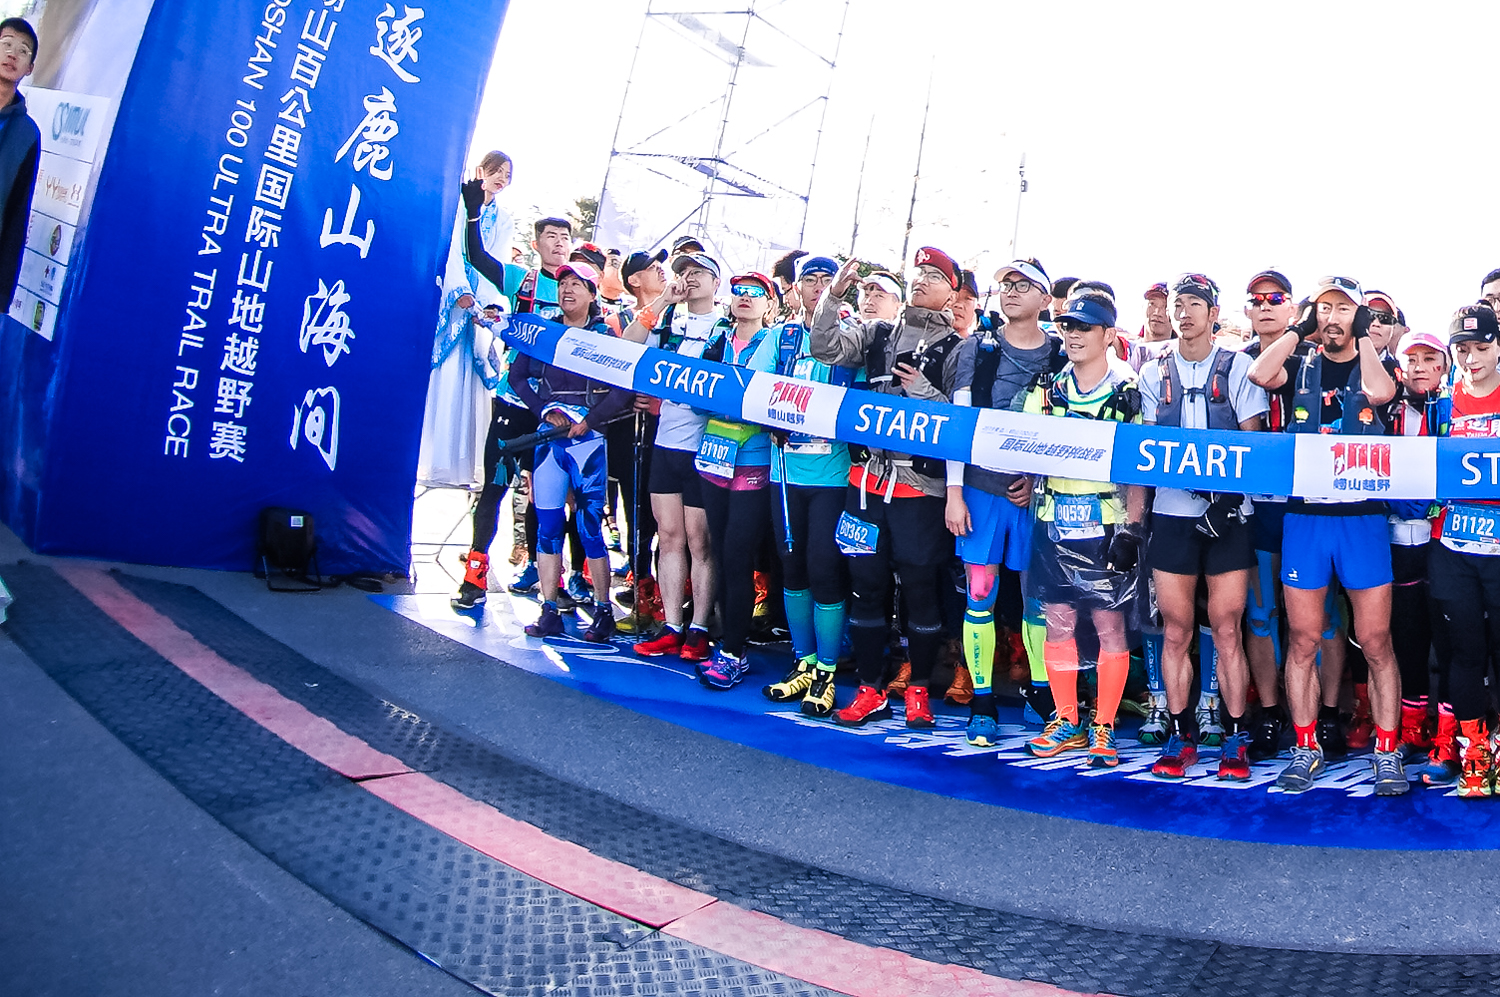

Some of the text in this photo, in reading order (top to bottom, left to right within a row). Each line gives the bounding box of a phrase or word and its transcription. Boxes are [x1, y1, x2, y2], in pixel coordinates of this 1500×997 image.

[223, 100, 257, 149] 100
[195, 153, 244, 258] ULTRA
[289, 1, 425, 472] 逐鹿山海间
[178, 269, 220, 359] TRAIL
[510, 318, 547, 347] START
[649, 361, 726, 399] START
[164, 365, 200, 459] RACE
[854, 403, 950, 446] START
[1136, 437, 1252, 479] START
[1451, 513, 1495, 537] B1122
